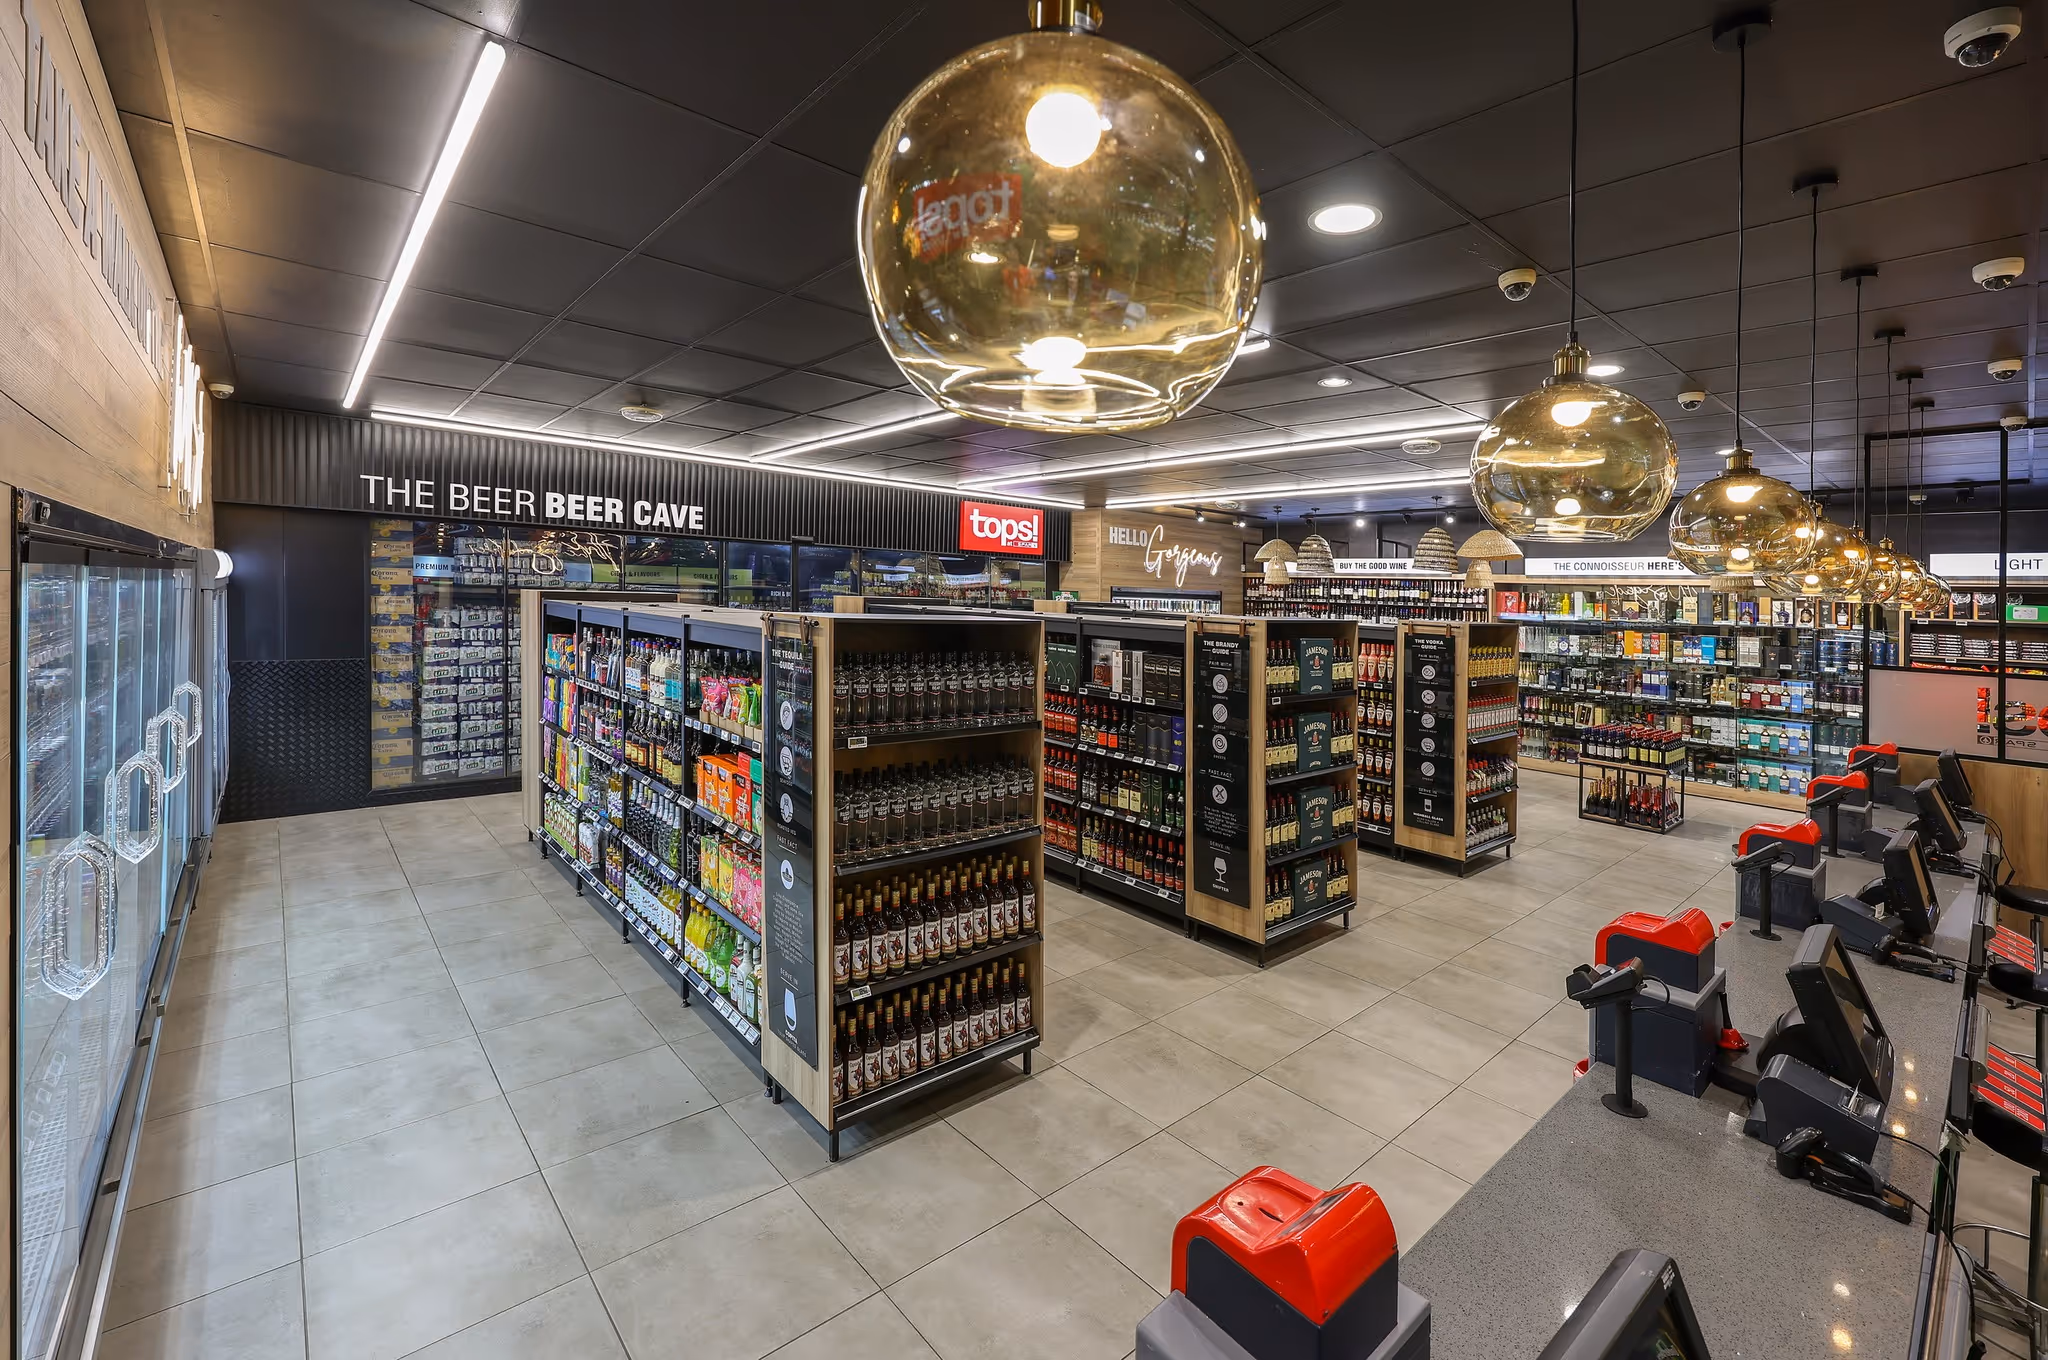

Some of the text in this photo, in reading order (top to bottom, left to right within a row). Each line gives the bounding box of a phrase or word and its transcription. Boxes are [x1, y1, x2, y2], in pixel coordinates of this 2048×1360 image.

[81, 150, 104, 260] A
[359, 474, 704, 530] THE BEER BEER CAVE
[970, 509, 1038, 548] tops!
[1109, 526, 1148, 547] HELLO
[1144, 524, 1222, 587] Gorgeous
[1369, 562, 1388, 570] GOOD
[1389, 562, 1407, 570] WINE
[1554, 562, 1684, 571] THE CONNOISSEUR HERE'S
[1995, 559, 2043, 570] LGHT
[772, 649, 803, 660] THE TEQUILA
[1305, 646, 1329, 657] JAMESON
[780, 661, 794, 670] GUIDE
[1304, 722, 1327, 735] JAMESON
[1305, 797, 1328, 811] JAMESON
[776, 835, 798, 849] FAST FACT
[1299, 870, 1323, 885] JAMESON
[780, 968, 792, 982] SERVE
